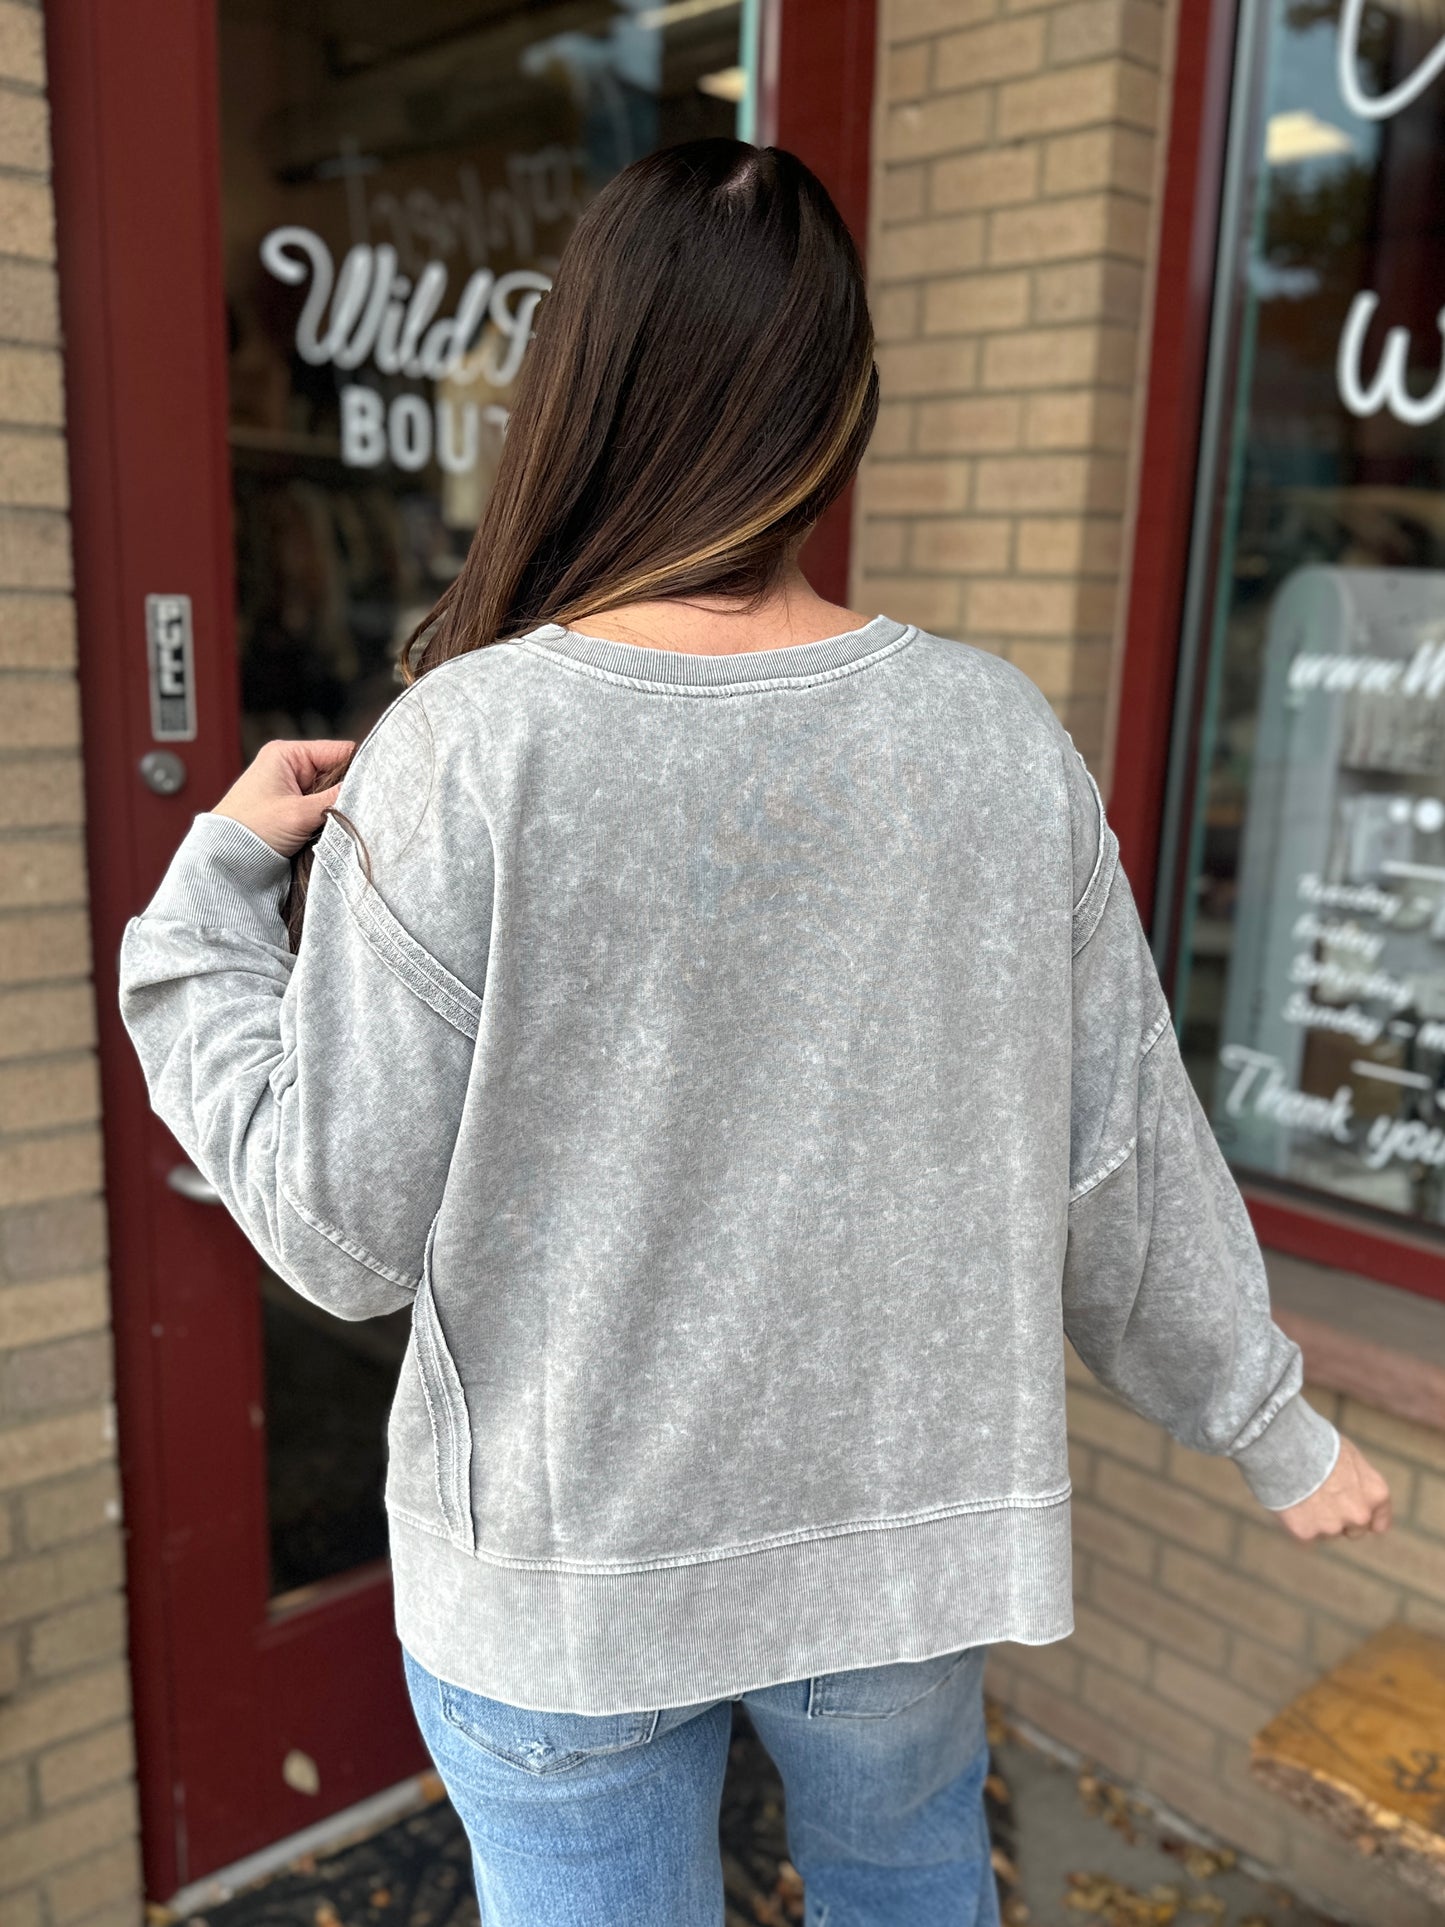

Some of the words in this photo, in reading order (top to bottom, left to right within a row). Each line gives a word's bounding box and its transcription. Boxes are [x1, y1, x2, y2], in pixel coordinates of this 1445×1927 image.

[260, 226, 494, 382] Wild
[156, 600, 185, 696] PULL
[1282, 992, 1383, 1044] Sunday
[1289, 953, 1414, 1008] Saturday
[1219, 1045, 1353, 1141] Thank
